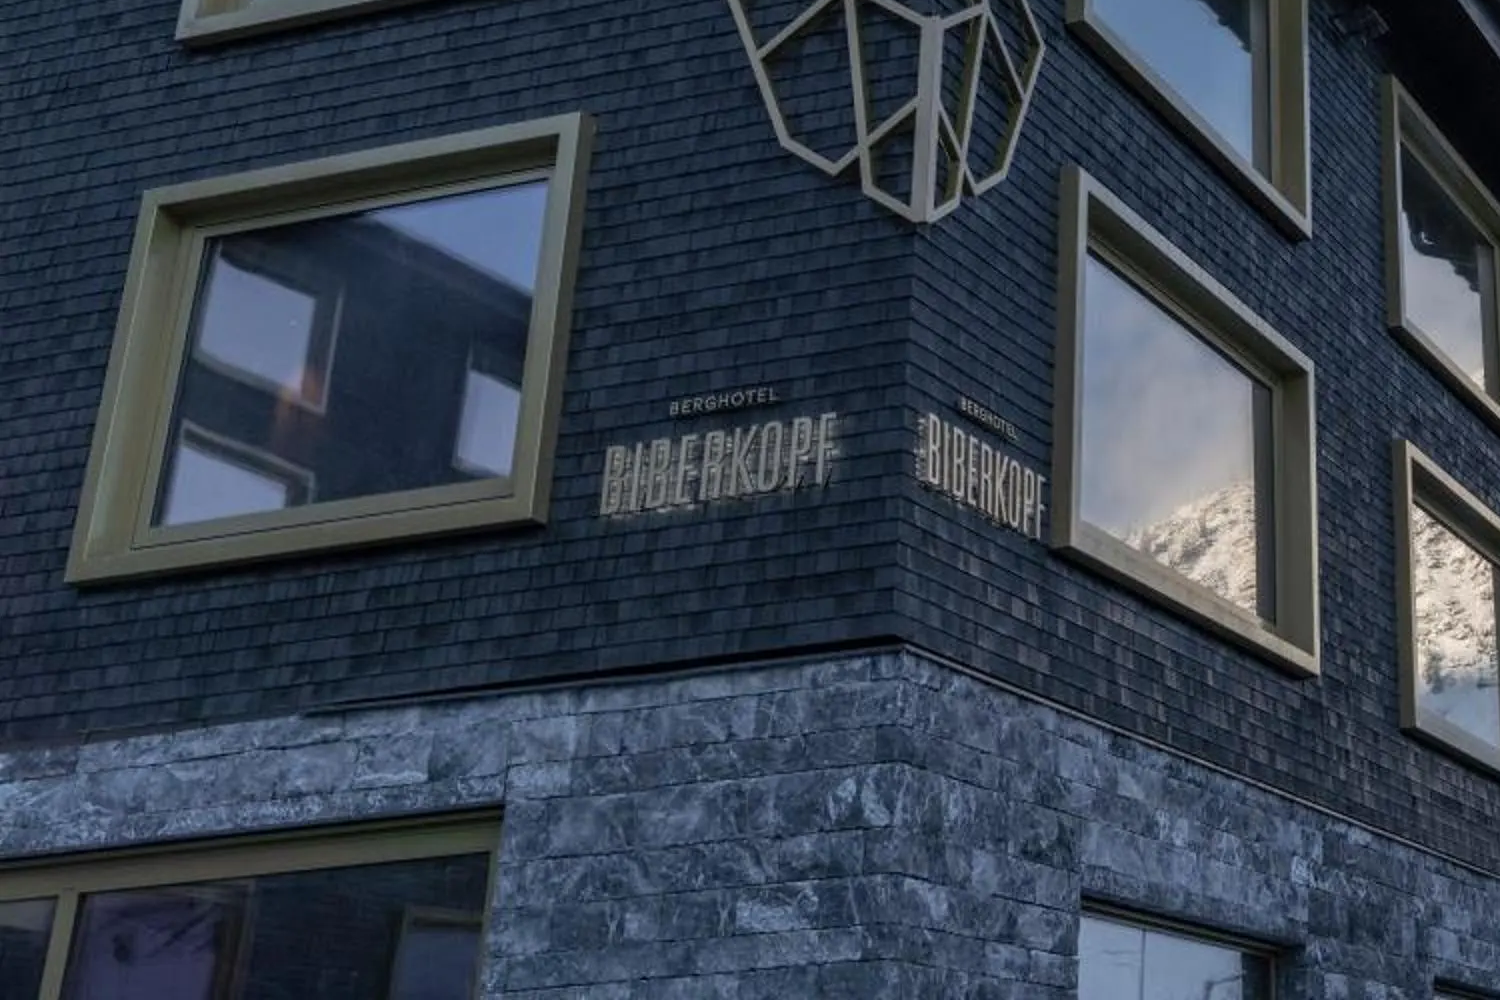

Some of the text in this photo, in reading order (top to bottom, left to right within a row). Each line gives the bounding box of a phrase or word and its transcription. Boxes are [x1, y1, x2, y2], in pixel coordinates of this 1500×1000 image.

[669, 387, 777, 416] BERGHOTEL
[961, 397, 1019, 440] BERGHOTEL
[601, 412, 837, 515] BIBERKOPF
[928, 412, 1047, 541] BIBERKOPF
